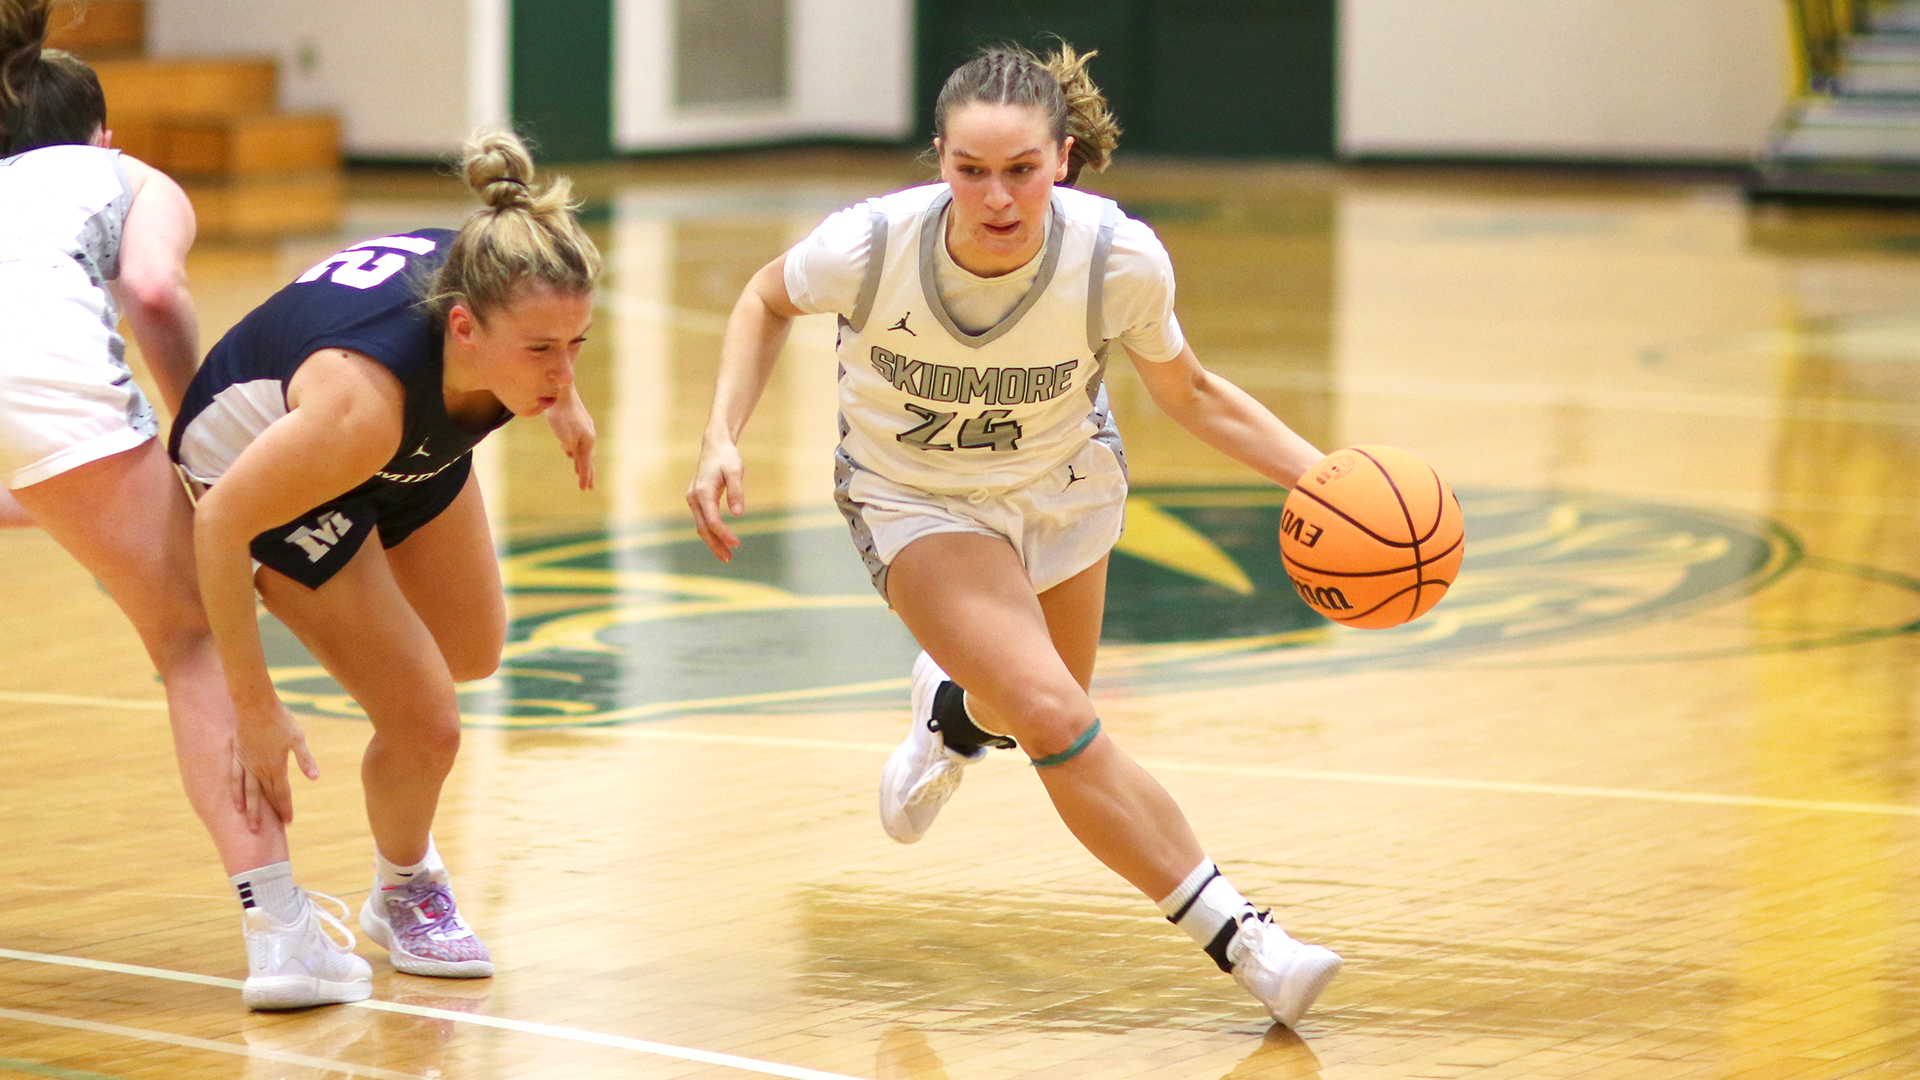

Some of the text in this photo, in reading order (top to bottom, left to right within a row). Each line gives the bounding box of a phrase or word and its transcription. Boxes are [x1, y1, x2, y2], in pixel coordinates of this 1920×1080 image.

[870, 345, 1079, 406] SKIDMORE
[896, 402, 1023, 451] 24
[284, 510, 353, 564] M
